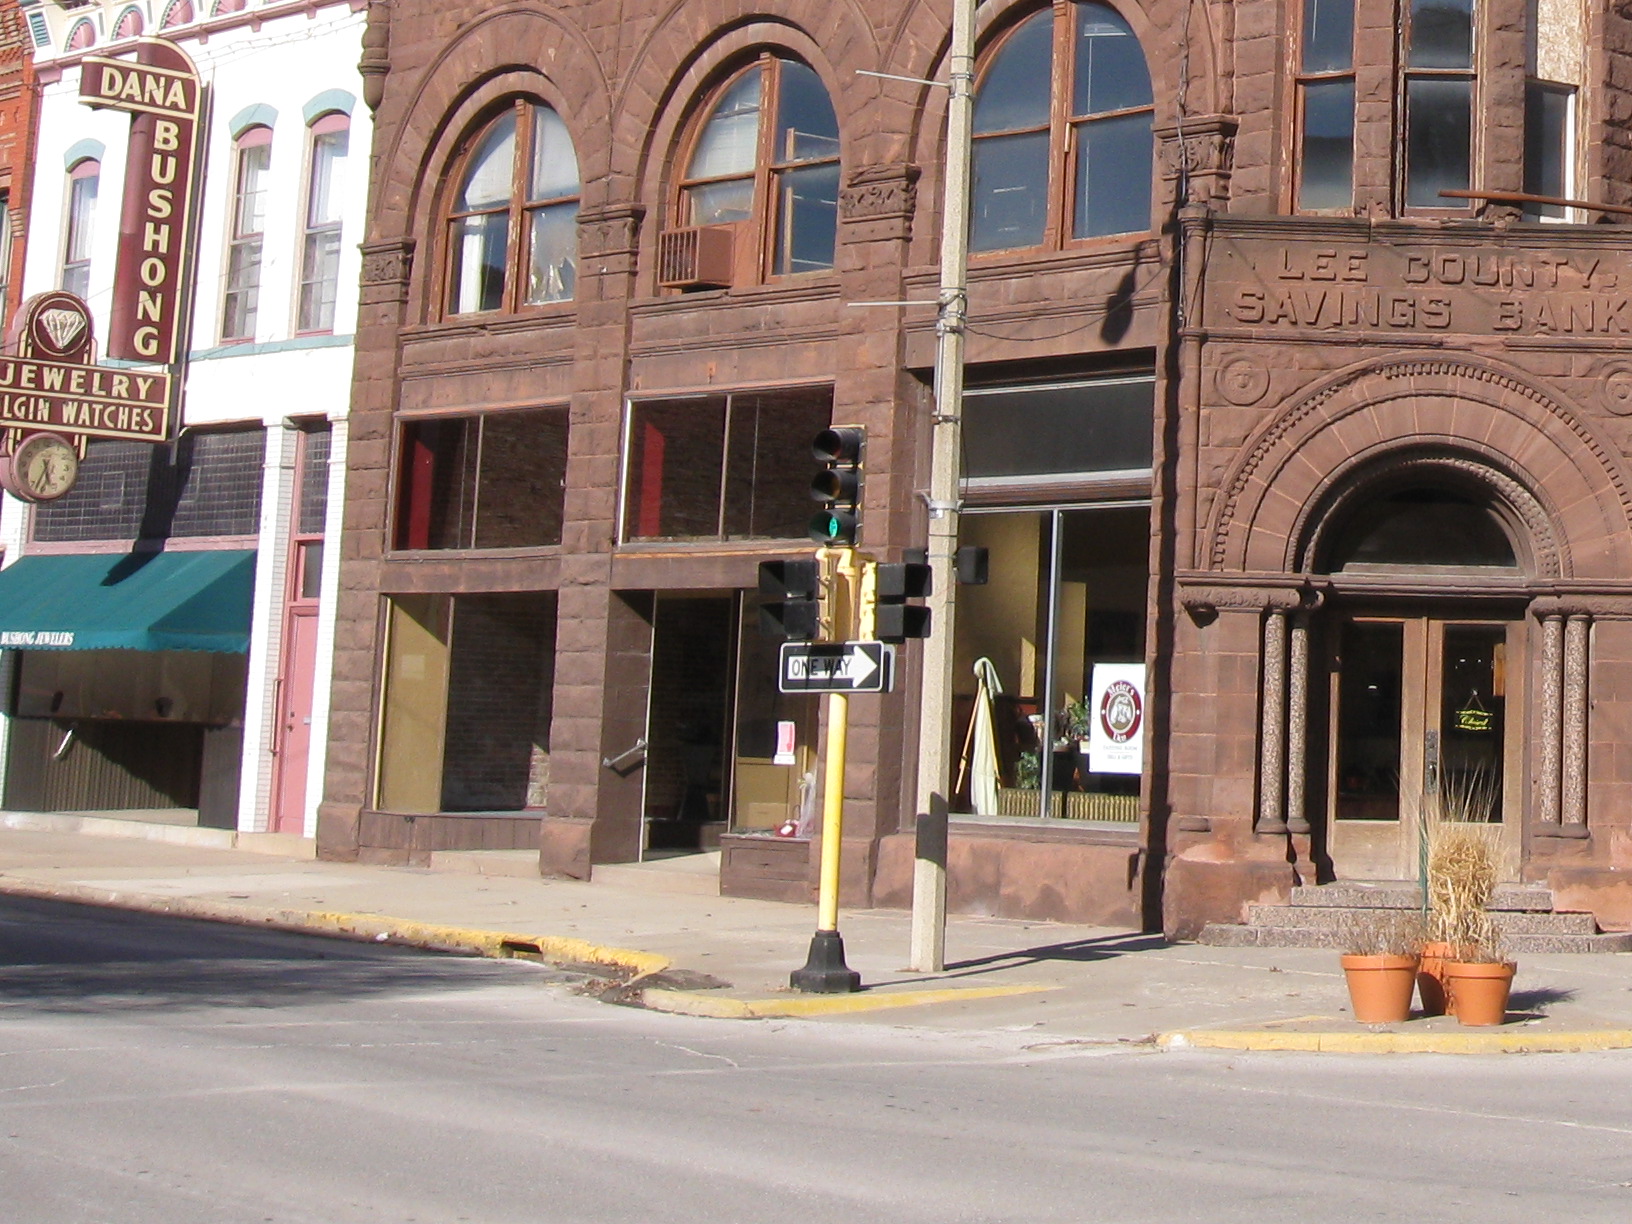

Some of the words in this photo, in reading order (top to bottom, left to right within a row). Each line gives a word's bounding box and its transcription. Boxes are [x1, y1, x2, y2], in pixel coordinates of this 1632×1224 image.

[101, 66, 186, 110] DANA
[133, 119, 180, 357] BUSHONG
[1277, 248, 1368, 283] LEE
[1233, 290, 1453, 329] SAVINGS
[0, 362, 154, 400] JEWELRY
[2, 394, 50, 422] LGIN
[62, 401, 153, 432] WATCHES
[792, 659, 818, 677] ONE
[824, 658, 852, 677] WAY
